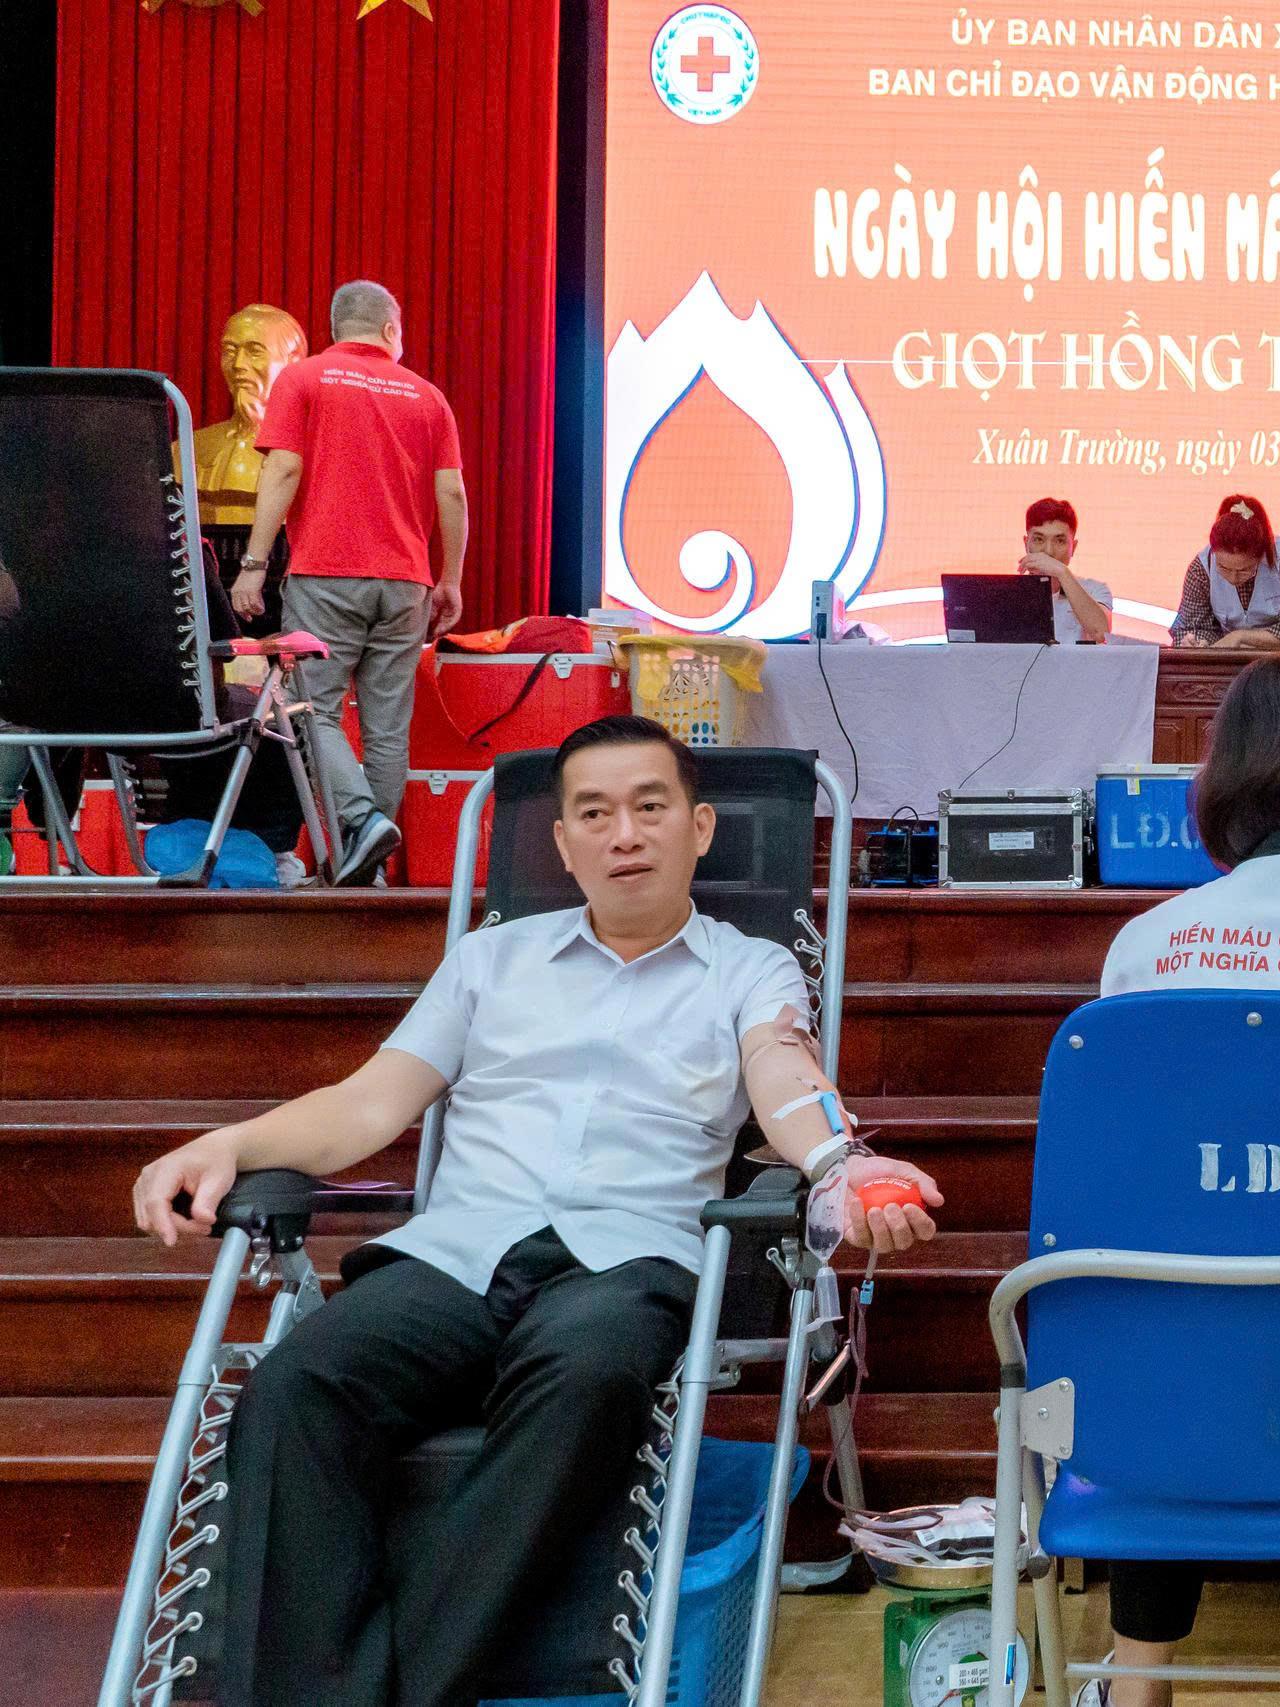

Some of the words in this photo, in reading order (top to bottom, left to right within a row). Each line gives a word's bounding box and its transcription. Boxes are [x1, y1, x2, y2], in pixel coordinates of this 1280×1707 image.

[951, 7, 996, 46] ỦY
[1007, 18, 1077, 46] BAN
[1088, 14, 1182, 48] NHÂN
[1193, 15, 1262, 49] DÂN
[868, 68, 936, 96] BAN
[946, 59, 1002, 97] CHỈ
[1011, 70, 1080, 103] ĐẠO
[1088, 64, 1154, 105] VẬN
[1164, 65, 1258, 105] ĐỘNG
[813, 162, 957, 280] NGÀY
[976, 164, 1063, 302] HỘI
[1084, 146, 1206, 282] HIẾN
[892, 328, 1047, 402] GIỌT
[1060, 310, 1245, 393] HỒNG
[972, 427, 1049, 465] Xuân
[1059, 428, 1168, 475] Trường,
[1175, 429, 1242, 476] ngày
[1169, 920, 1215, 948] HIẾN
[1222, 926, 1272, 948] MÁU
[1156, 951, 1194, 975] MỘT
[1199, 950, 1270, 973] NGHĨA
